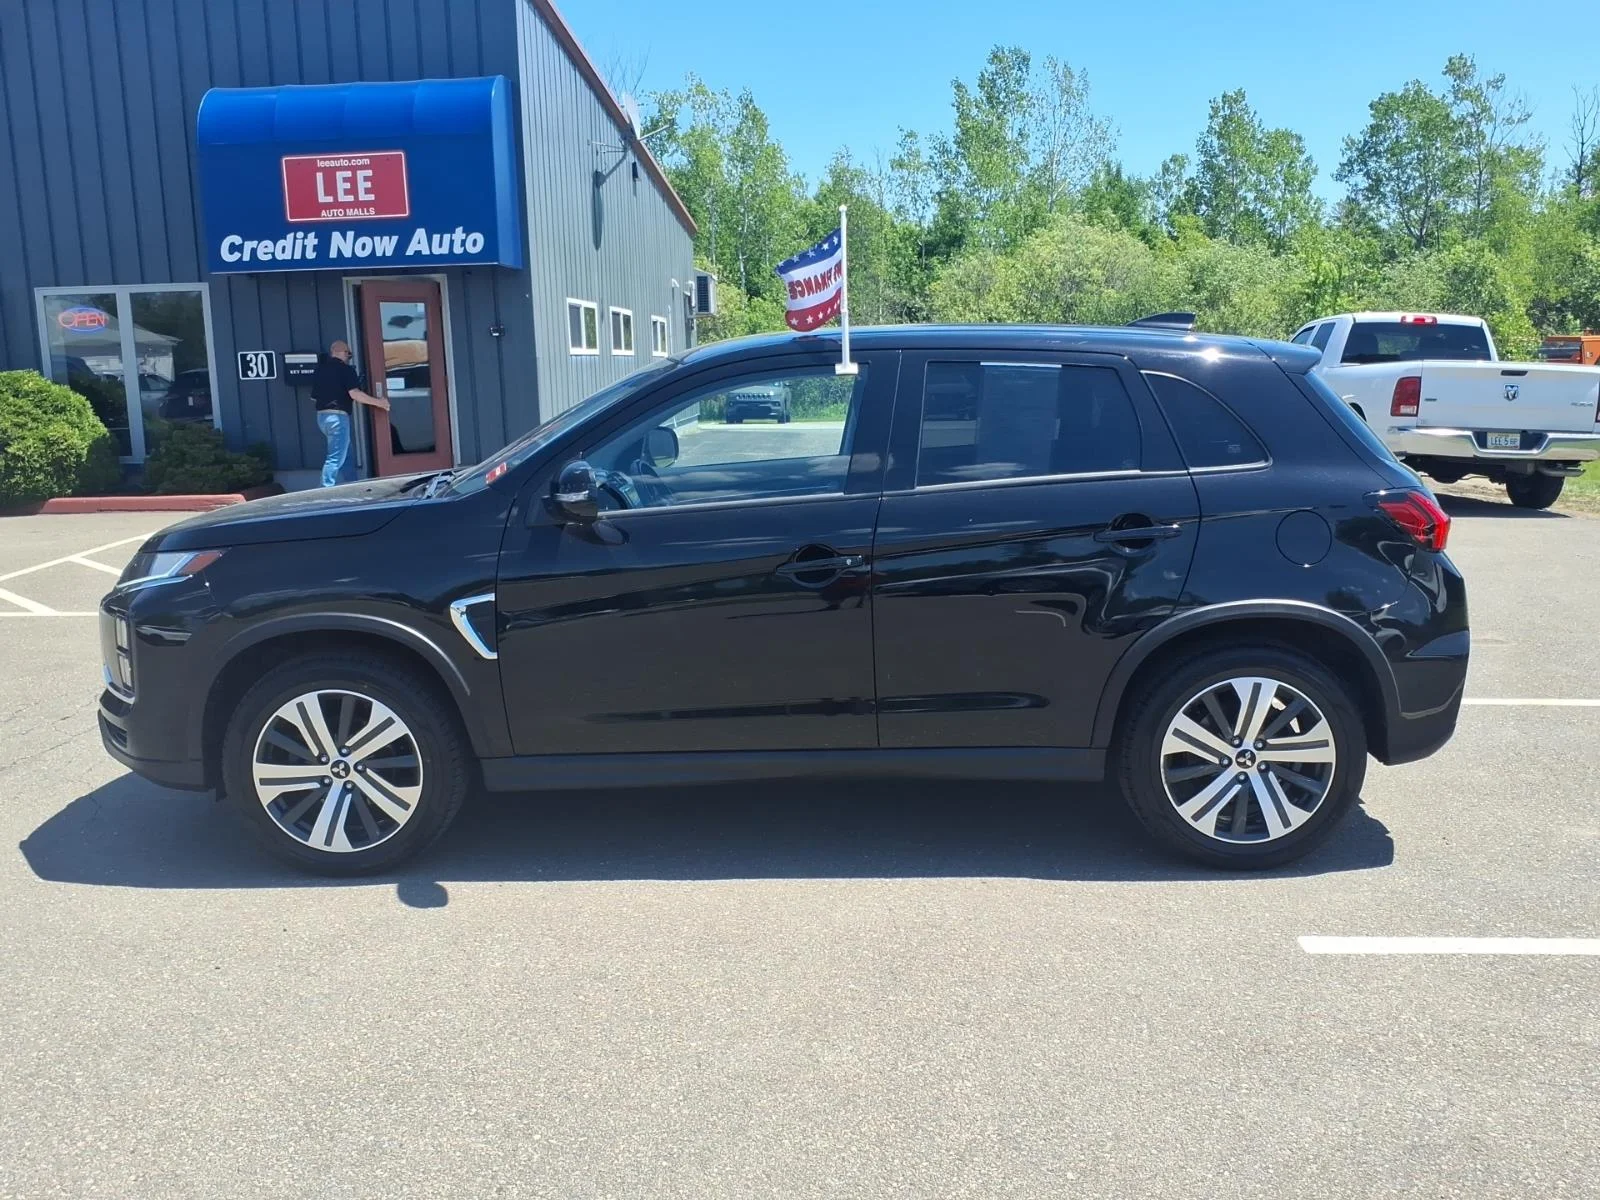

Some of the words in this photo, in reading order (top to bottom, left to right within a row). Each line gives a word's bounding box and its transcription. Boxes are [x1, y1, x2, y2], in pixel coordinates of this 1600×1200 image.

[317, 158, 370, 168] leeauto.com
[316, 169, 375, 204] LEE
[320, 208, 345, 218] AUTO
[346, 207, 376, 217] MALLS
[220, 231, 318, 263] Credit
[329, 230, 398, 259] Now
[405, 226, 485, 256] Auto
[59, 312, 106, 328] OPEN
[246, 353, 268, 378] 30
